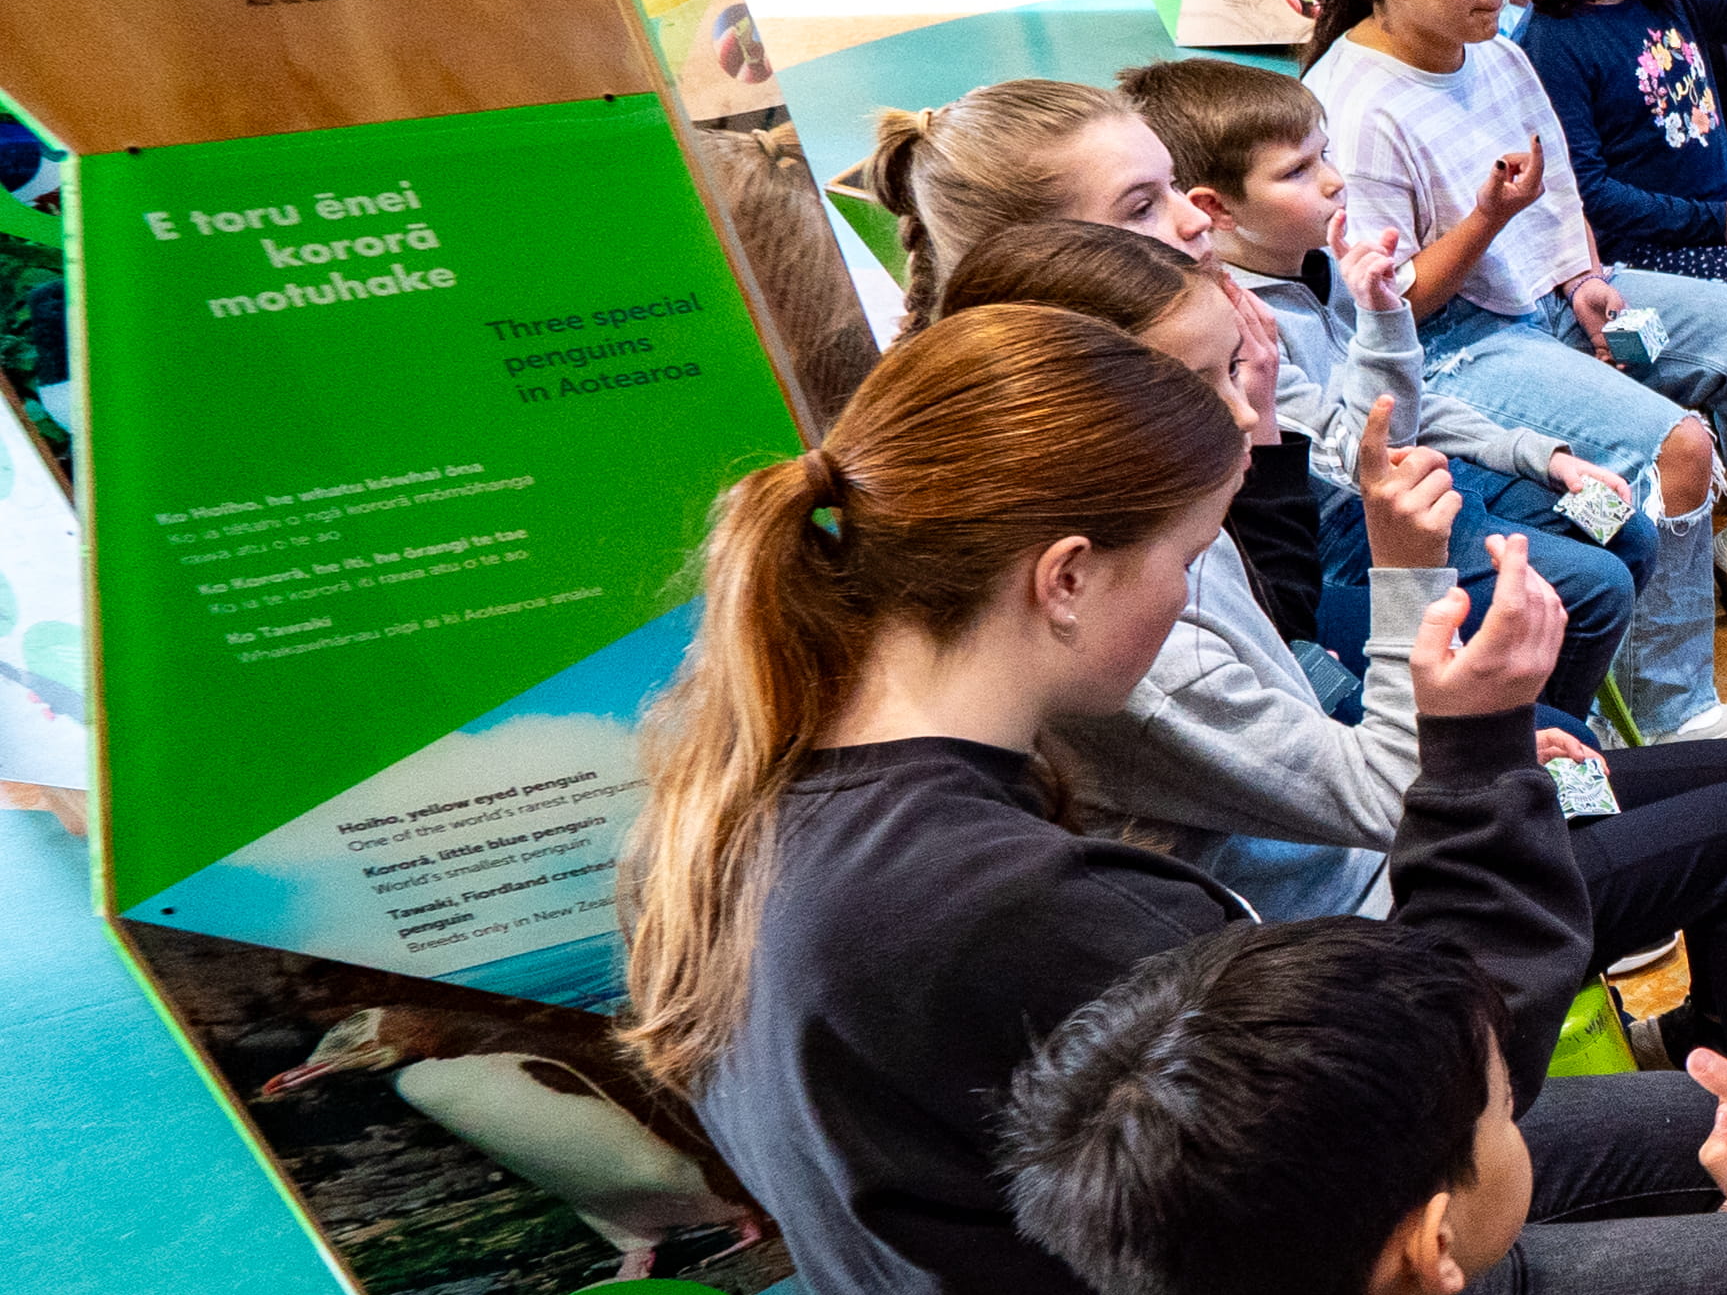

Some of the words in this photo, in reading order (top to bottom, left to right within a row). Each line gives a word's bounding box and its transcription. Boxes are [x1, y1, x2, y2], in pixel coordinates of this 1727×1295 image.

[1666, 75, 1699, 106] hey
[143, 211, 181, 240] E
[189, 205, 300, 236] toru
[313, 180, 422, 220] ēnei
[260, 223, 440, 268] kororā
[207, 264, 456, 318] motuhake
[484, 314, 584, 341] Three
[592, 292, 703, 329] special
[502, 337, 653, 378] penguins
[515, 384, 550, 403] in
[559, 361, 701, 397] Aotearoa
[337, 815, 405, 835] Hoiho,
[406, 798, 471, 822] yellow
[473, 786, 518, 806] eyed
[522, 770, 598, 797] penguin
[348, 836, 388, 852] One
[393, 829, 412, 843] of
[415, 822, 446, 837] the
[517, 796, 567, 814] rarest
[437, 843, 485, 862] little
[486, 832, 529, 850] blue
[531, 816, 607, 842] penguin
[444, 854, 518, 879] smallest
[521, 837, 592, 863] penguin
[386, 897, 459, 920] Tawaki,
[461, 874, 549, 903] Fiordland
[551, 858, 617, 881] crested
[397, 911, 475, 939] penguin
[407, 932, 468, 953] Breeds
[471, 922, 510, 941] only
[513, 917, 530, 928] in
[533, 905, 573, 922] New
